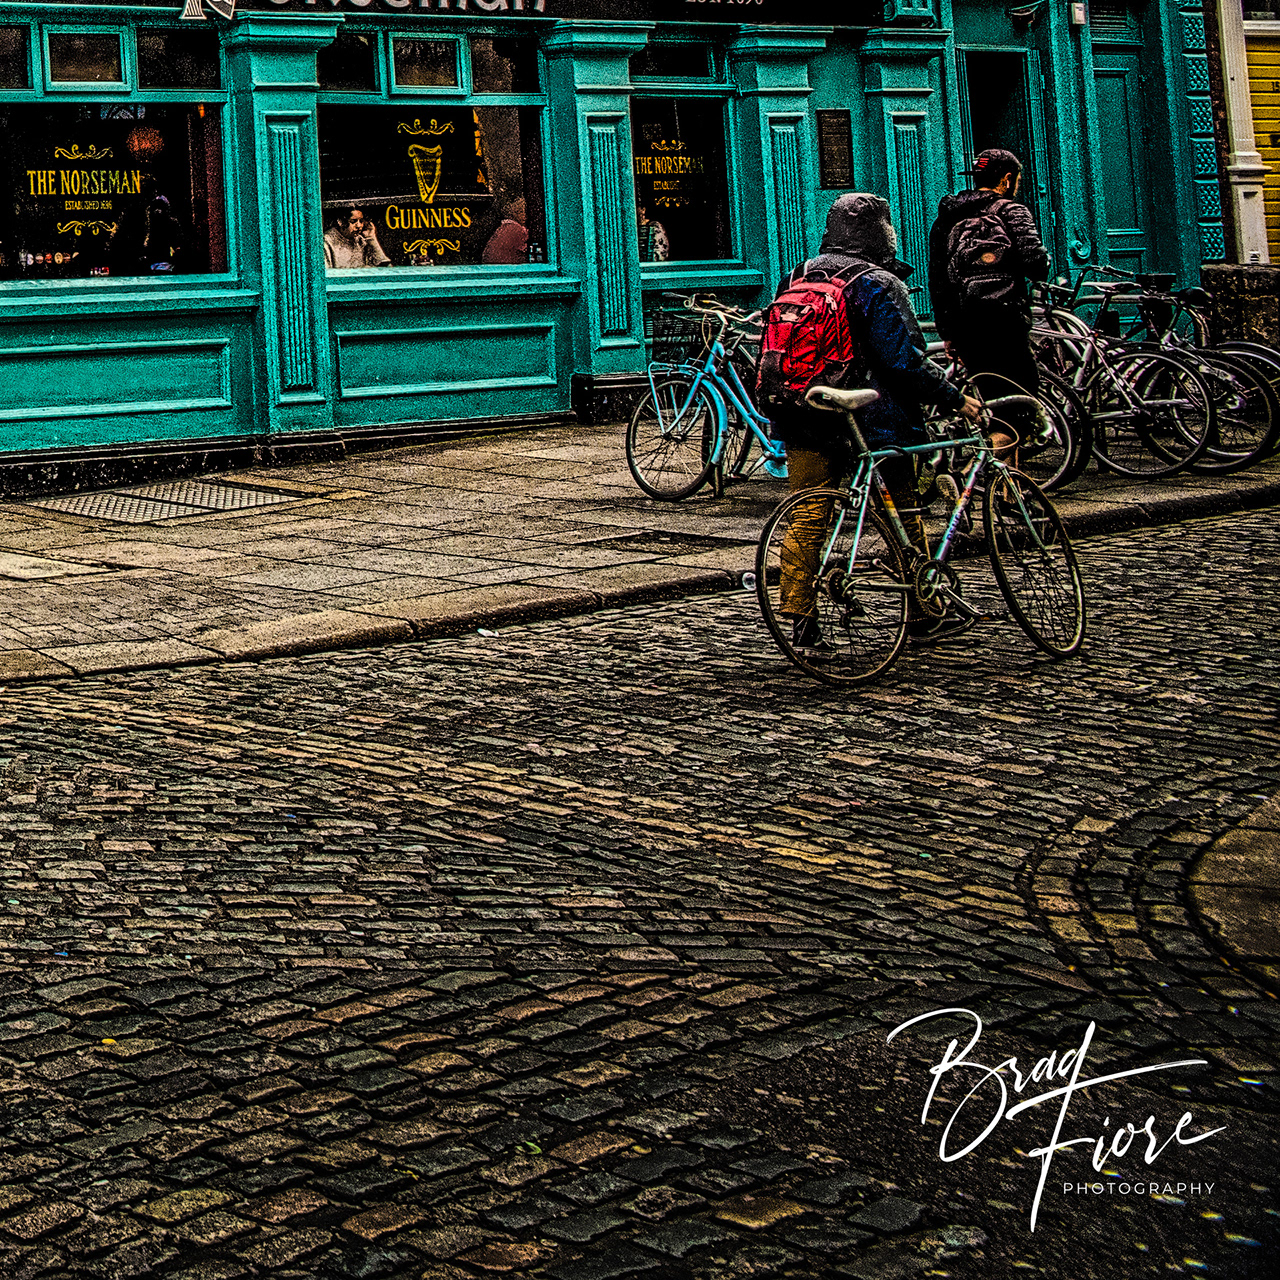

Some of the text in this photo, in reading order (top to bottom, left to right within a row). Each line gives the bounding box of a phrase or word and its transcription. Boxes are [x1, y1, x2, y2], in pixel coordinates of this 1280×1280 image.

[636, 156, 651, 174] THE
[27, 170, 140, 195] THE NORSEMAN
[65, 201, 98, 210] ESTABLISHED
[385, 205, 471, 230] GUINNESS
